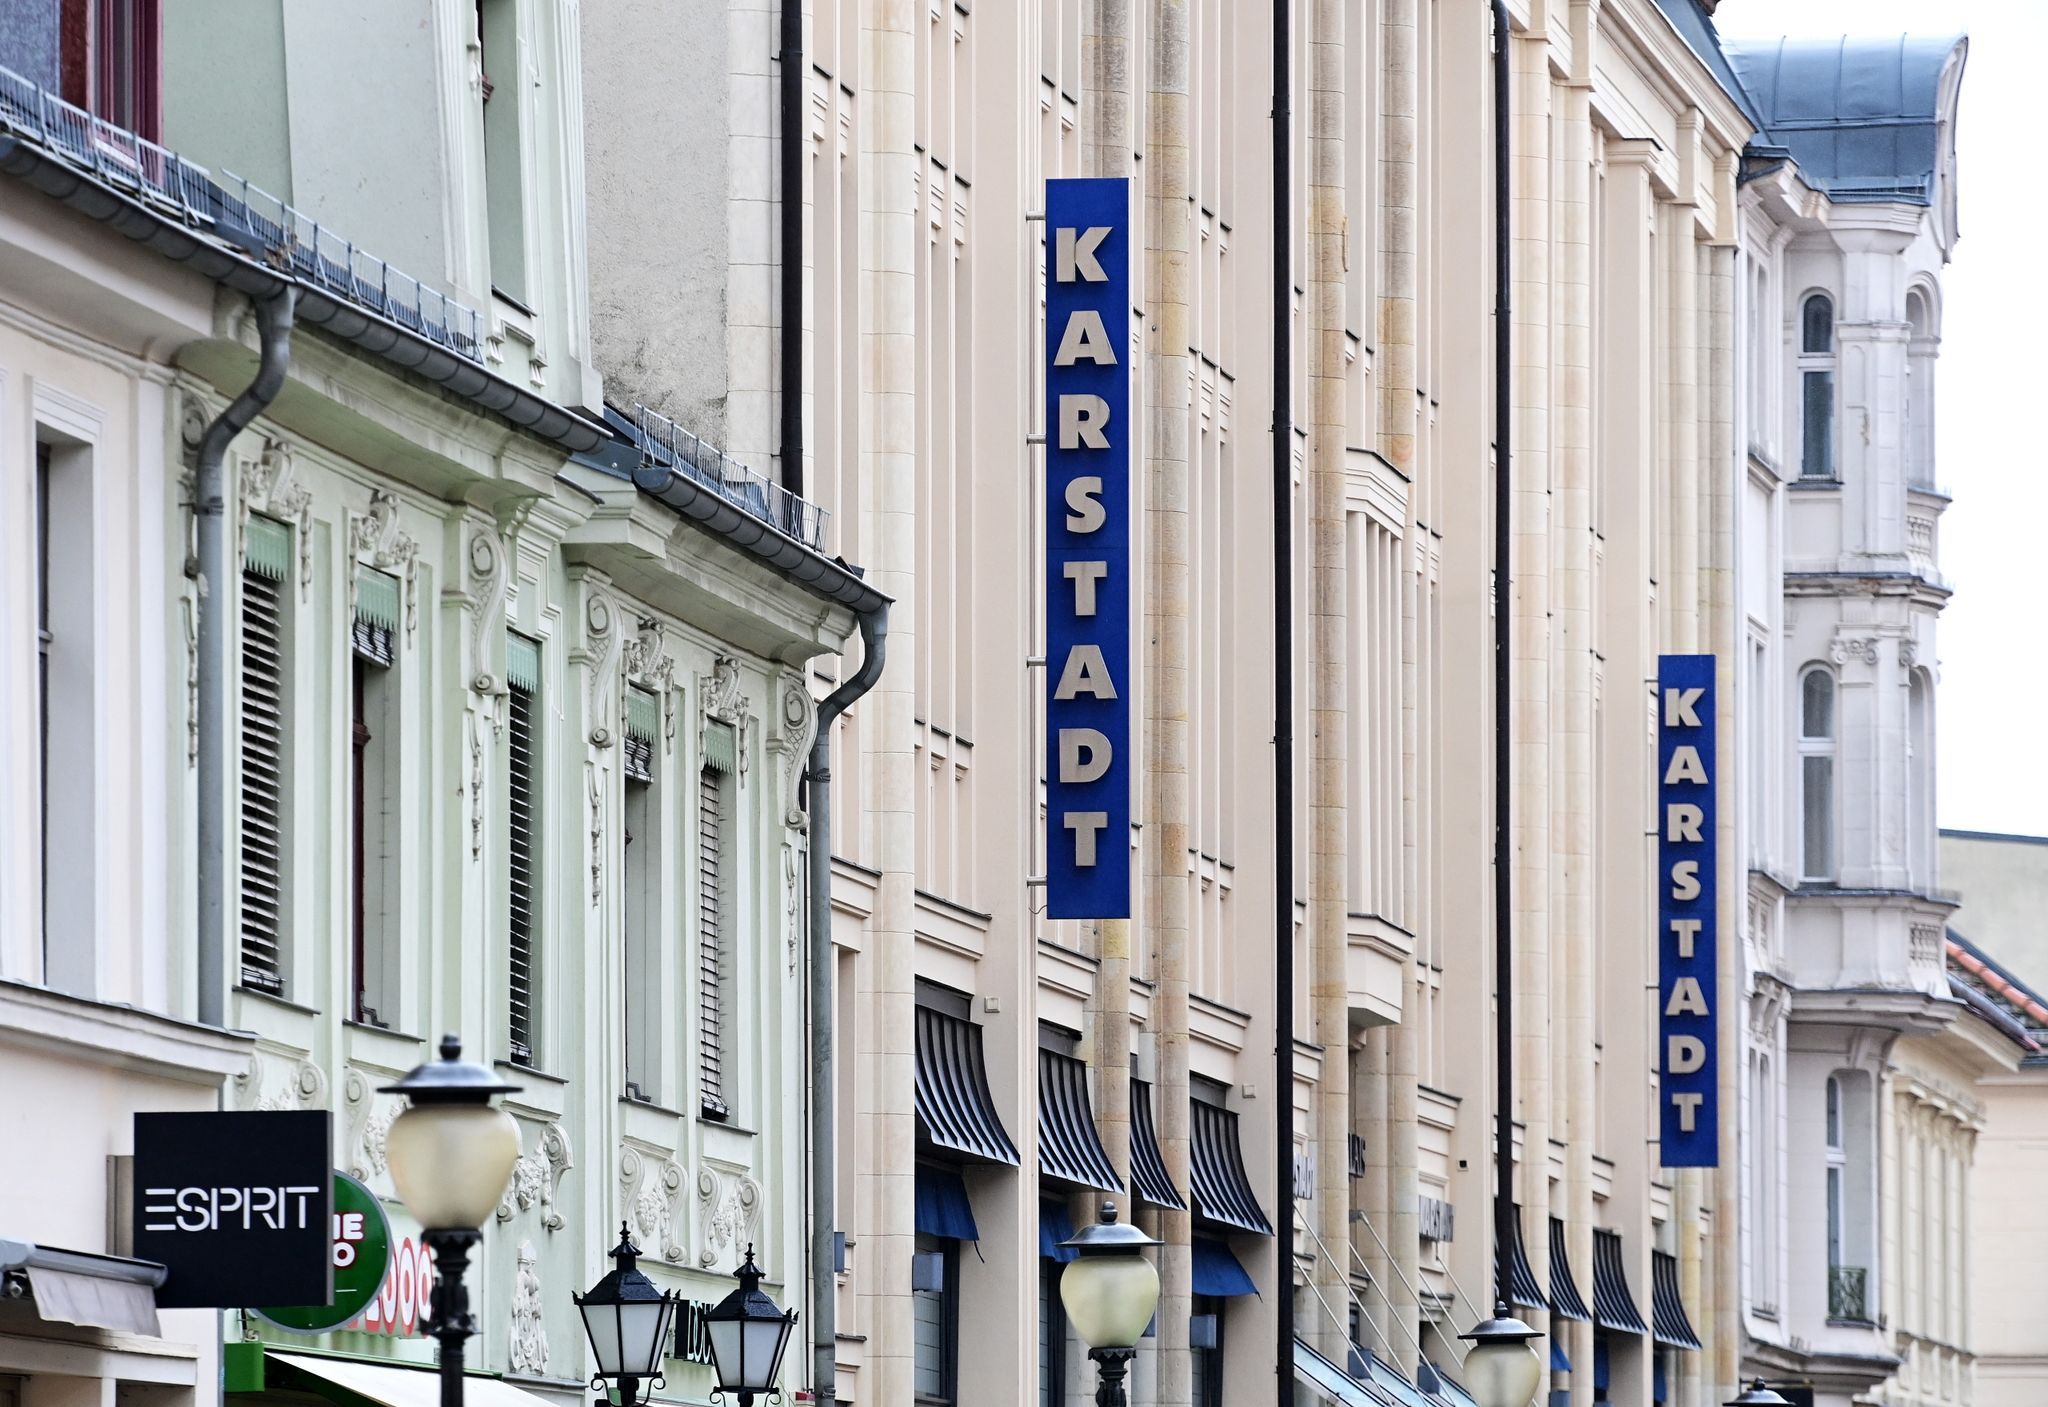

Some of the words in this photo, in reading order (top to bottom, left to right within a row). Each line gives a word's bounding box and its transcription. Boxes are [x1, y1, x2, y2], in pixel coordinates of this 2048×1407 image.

[1053, 225, 1119, 867] KARSTADT
[1663, 687, 1710, 1133] KARSTADT
[144, 1186, 319, 1232] ESPRIT
